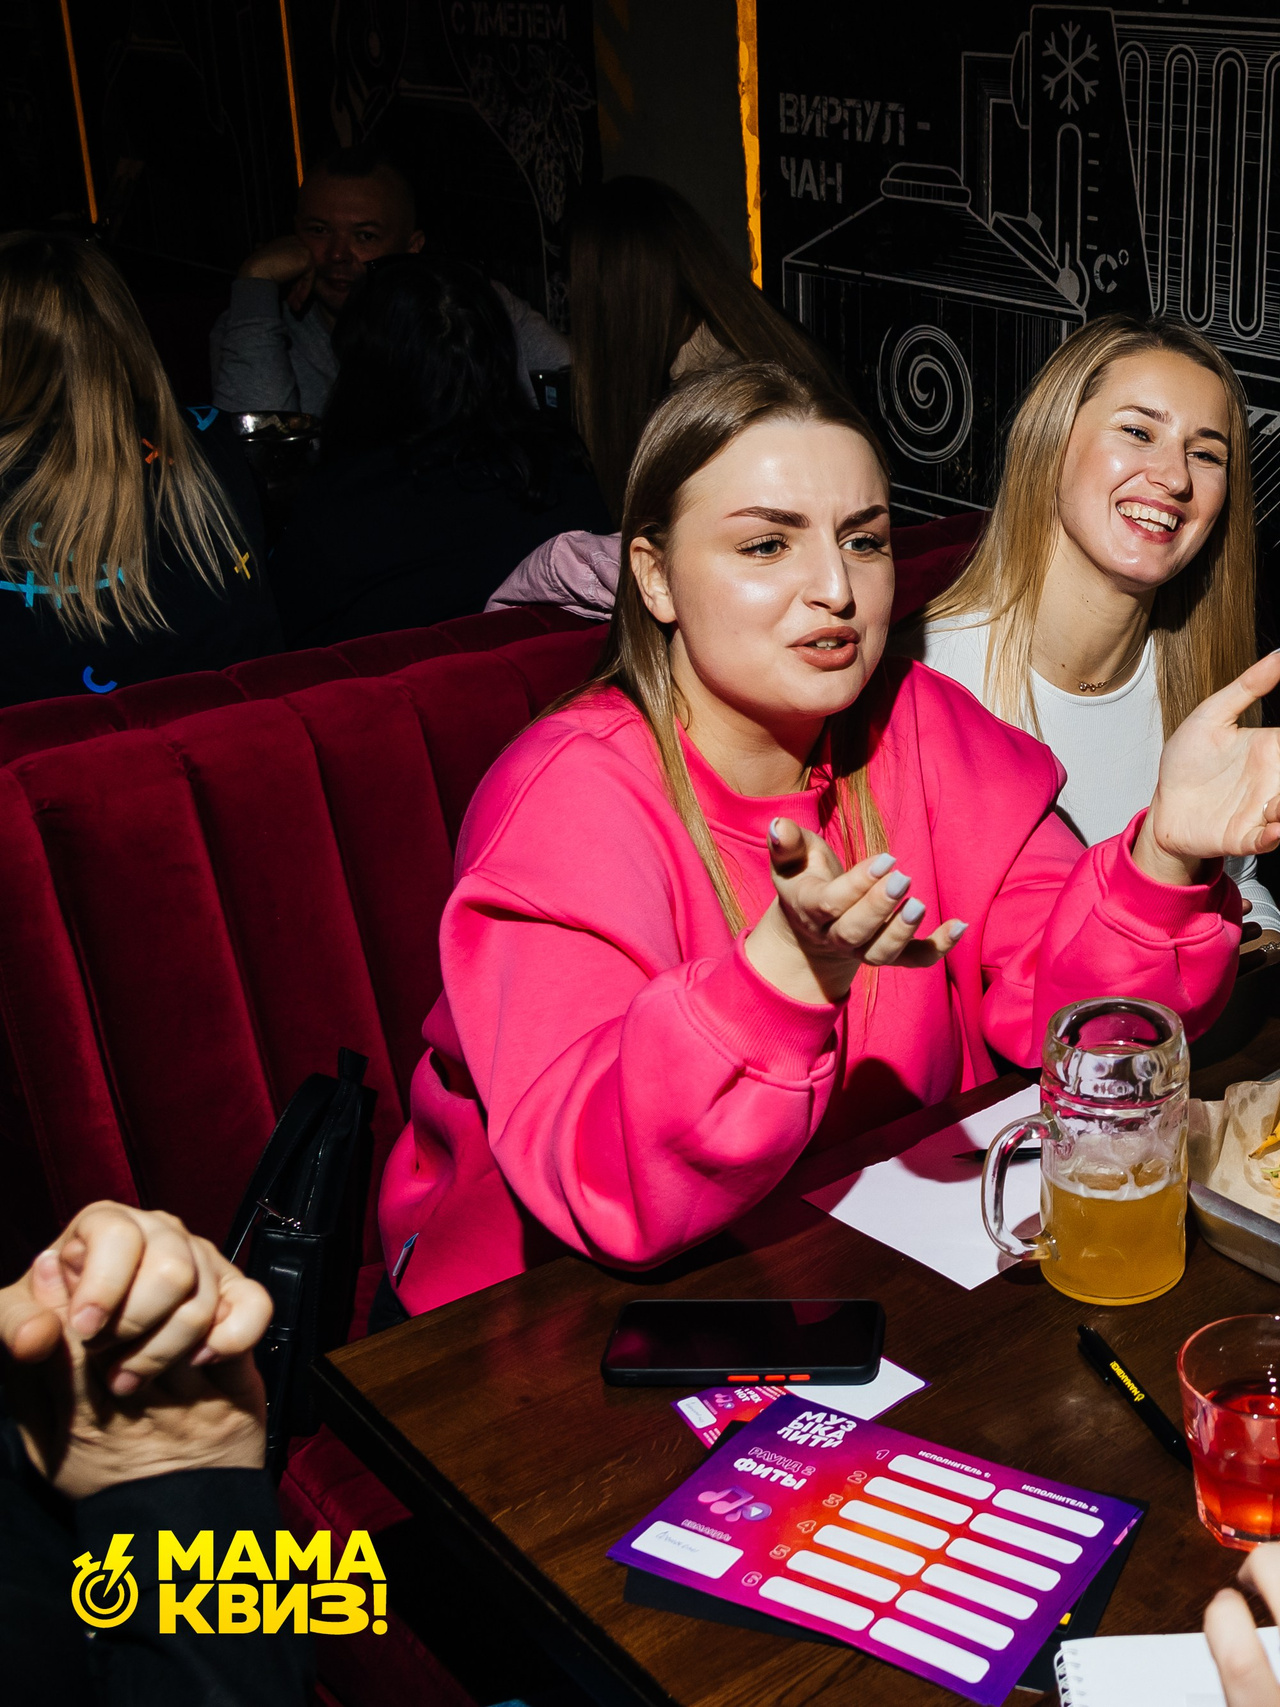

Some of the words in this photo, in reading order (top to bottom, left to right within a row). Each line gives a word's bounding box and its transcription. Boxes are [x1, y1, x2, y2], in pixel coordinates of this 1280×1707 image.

[779, 92, 905, 146] ВИРПУЛ
[780, 155, 843, 204] ЧАН
[787, 1420, 846, 1441] ЫКА
[796, 1411, 857, 1432] МУЗ
[776, 1427, 844, 1448] ЛИТИ
[747, 1446, 804, 1473] РАУНД
[801, 1465, 816, 1476] 2
[875, 1449, 890, 1460] 1
[917, 1450, 983, 1477] ИСПОЛНИТЕЛЬ
[733, 1457, 807, 1490] ФИТЫ
[847, 1470, 867, 1484] 2
[822, 1493, 844, 1509] 3
[1021, 1483, 1089, 1511] ИСПОЛНИТЕЛЬ
[797, 1519, 817, 1534] 4
[769, 1543, 791, 1560] 5
[741, 1570, 763, 1588] 6
